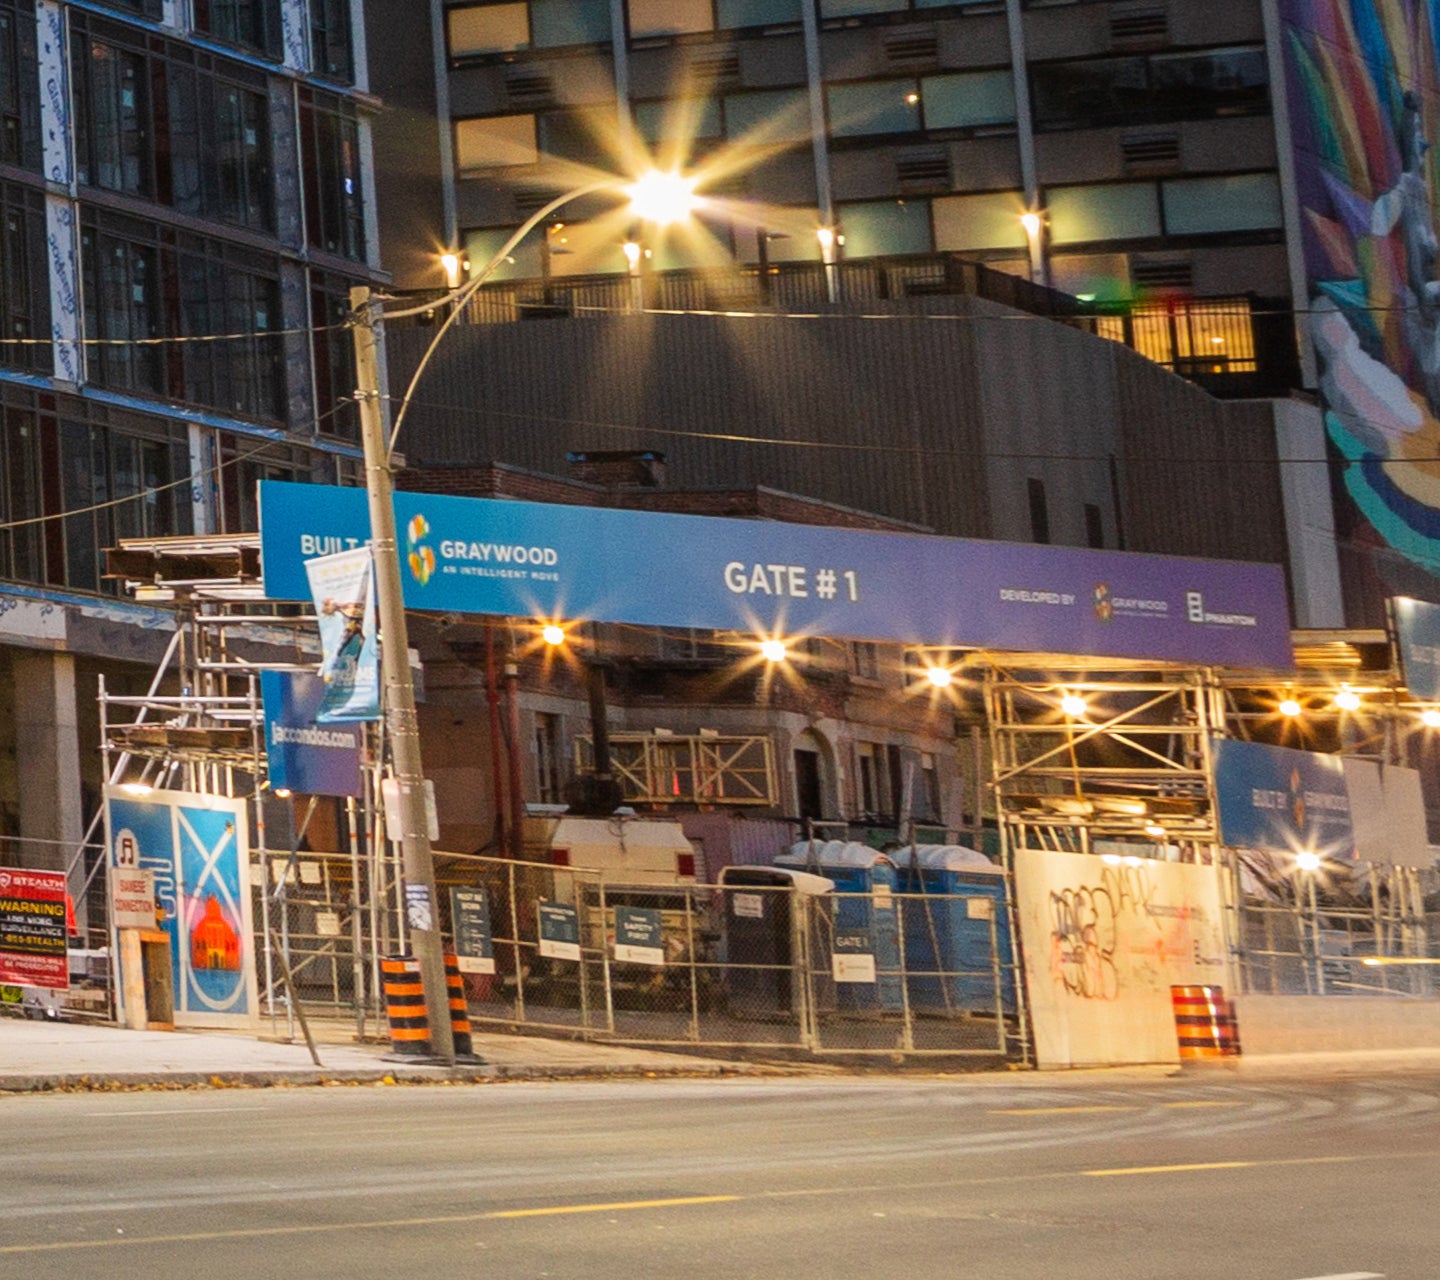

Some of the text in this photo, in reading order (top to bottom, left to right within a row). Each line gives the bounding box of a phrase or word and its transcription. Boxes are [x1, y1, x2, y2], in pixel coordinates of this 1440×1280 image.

[301, 534, 358, 555] BUILT
[440, 540, 558, 566] GRAYWOOD
[443, 565, 559, 581] AN INTELLIGENT MOVE
[724, 561, 858, 601] GATE # 1
[1000, 589, 1076, 605] DEVELOPED BY
[1112, 597, 1168, 611] GRAYWOOD
[272, 721, 356, 749] jaccondos.com
[13, 877, 64, 888] STEALTH
[0, 900, 64, 916] WARNING
[836, 936, 861, 947] GATE
